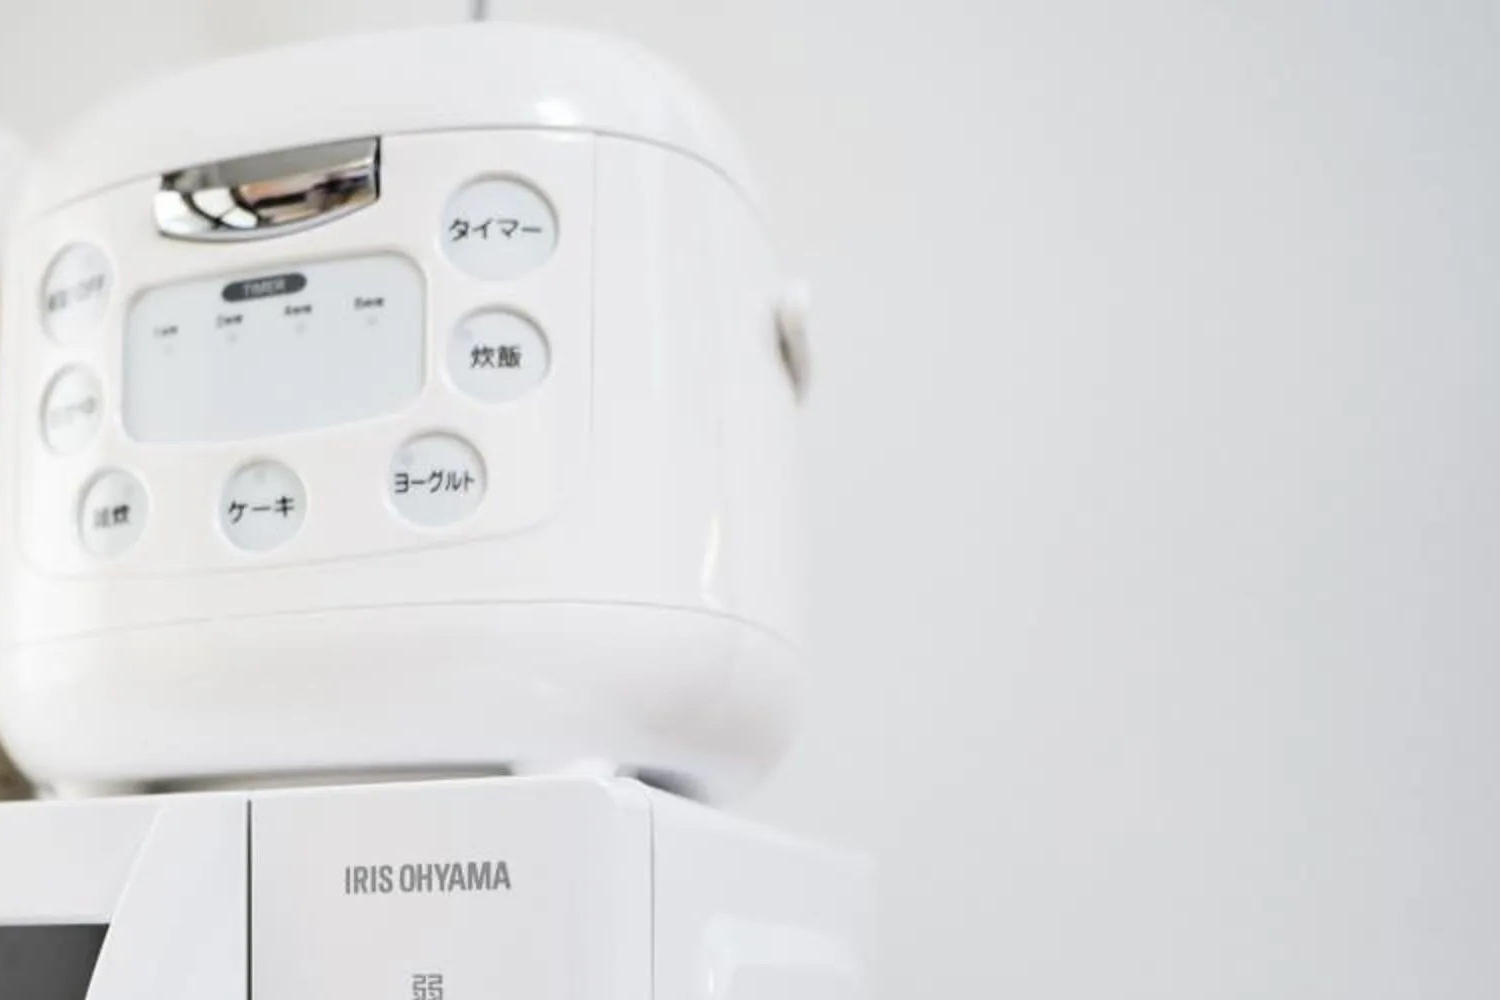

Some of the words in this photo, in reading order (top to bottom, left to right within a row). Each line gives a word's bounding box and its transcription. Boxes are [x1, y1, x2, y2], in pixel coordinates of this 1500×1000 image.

[449, 219, 541, 241] タイマー
[243, 278, 286, 297] TIMER
[471, 346, 520, 368] 炊飯
[395, 471, 474, 493] ヨーグルト
[228, 496, 293, 523] ケーキ
[345, 865, 393, 894] IRIS
[400, 861, 511, 892] OHYAMA
